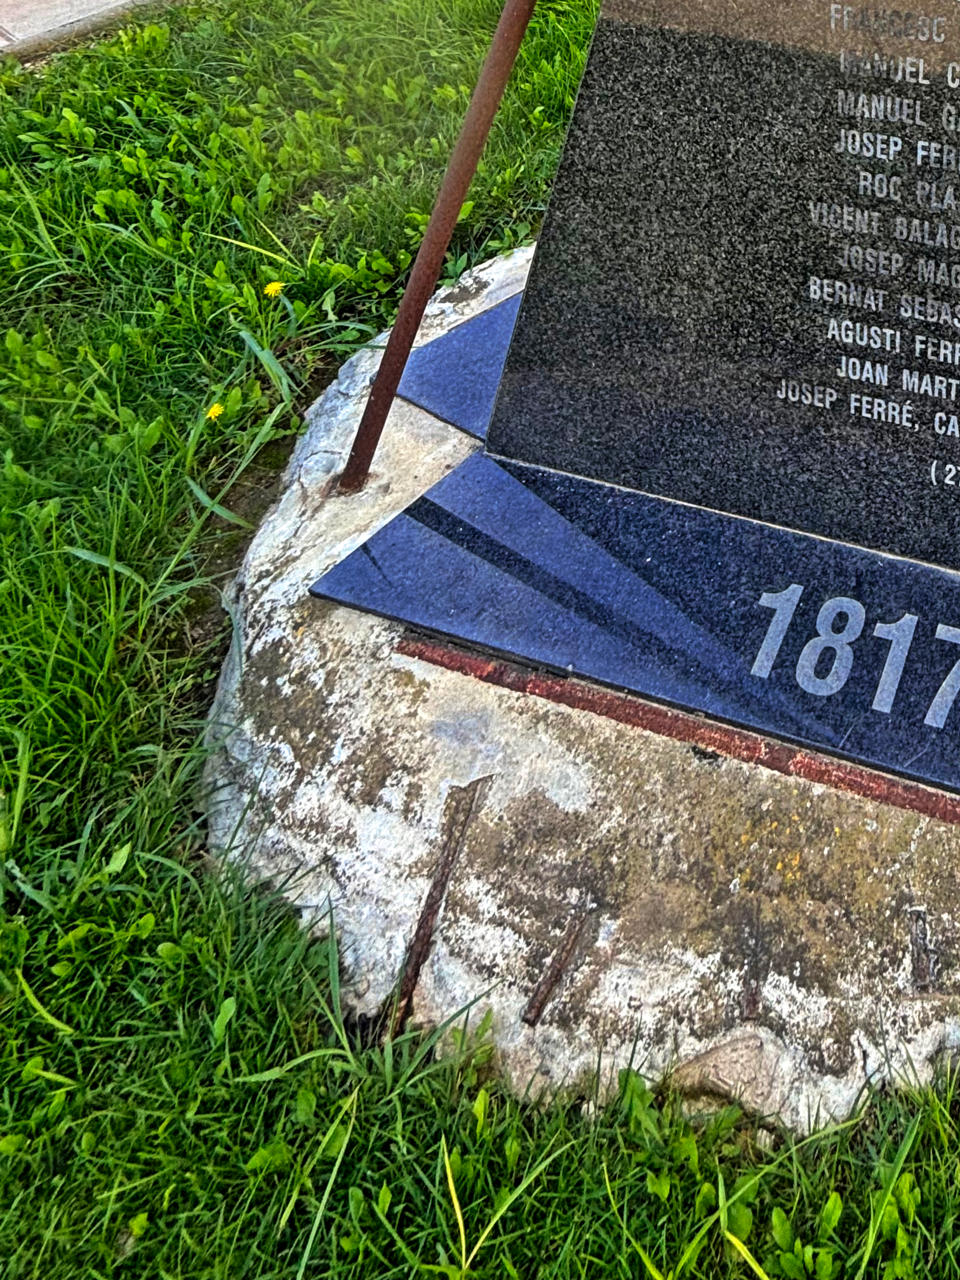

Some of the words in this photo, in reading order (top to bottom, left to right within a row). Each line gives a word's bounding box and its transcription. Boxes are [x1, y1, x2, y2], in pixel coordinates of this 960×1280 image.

[840, 50, 930, 84] MANUEL
[837, 89, 927, 127] MANUEL
[836, 128, 902, 161] JOSEP
[858, 171, 901, 200] ROC
[917, 181, 957, 213] PLA
[808, 200, 881, 236] VICENT
[840, 244, 903, 275] JOSEP
[809, 276, 889, 311] BERNAT
[836, 356, 888, 386] JOAN
[776, 379, 838, 409] JOSEP
[850, 393, 920, 432] FERRÉ,
